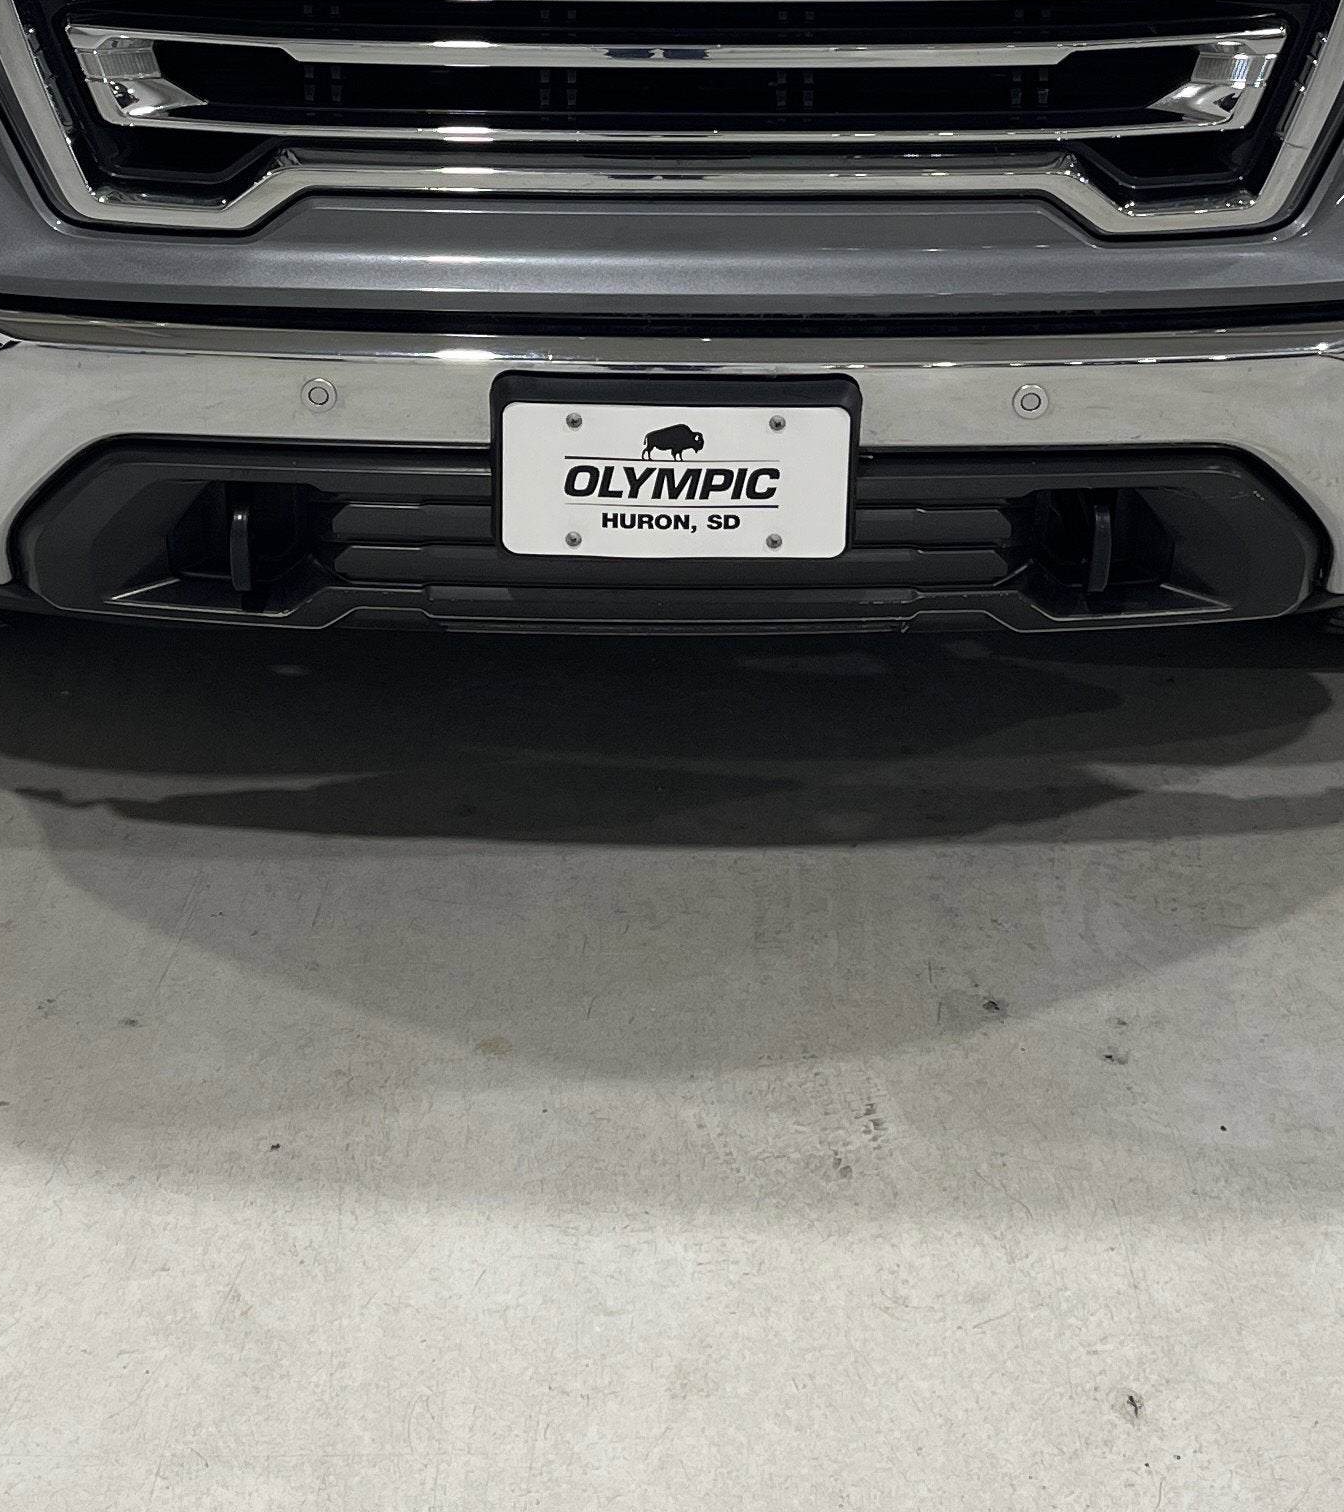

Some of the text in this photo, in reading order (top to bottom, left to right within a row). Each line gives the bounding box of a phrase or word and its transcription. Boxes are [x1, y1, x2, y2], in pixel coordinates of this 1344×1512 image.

[564, 465, 780, 501] OLYMPIC
[601, 512, 741, 534] HURON, SD
